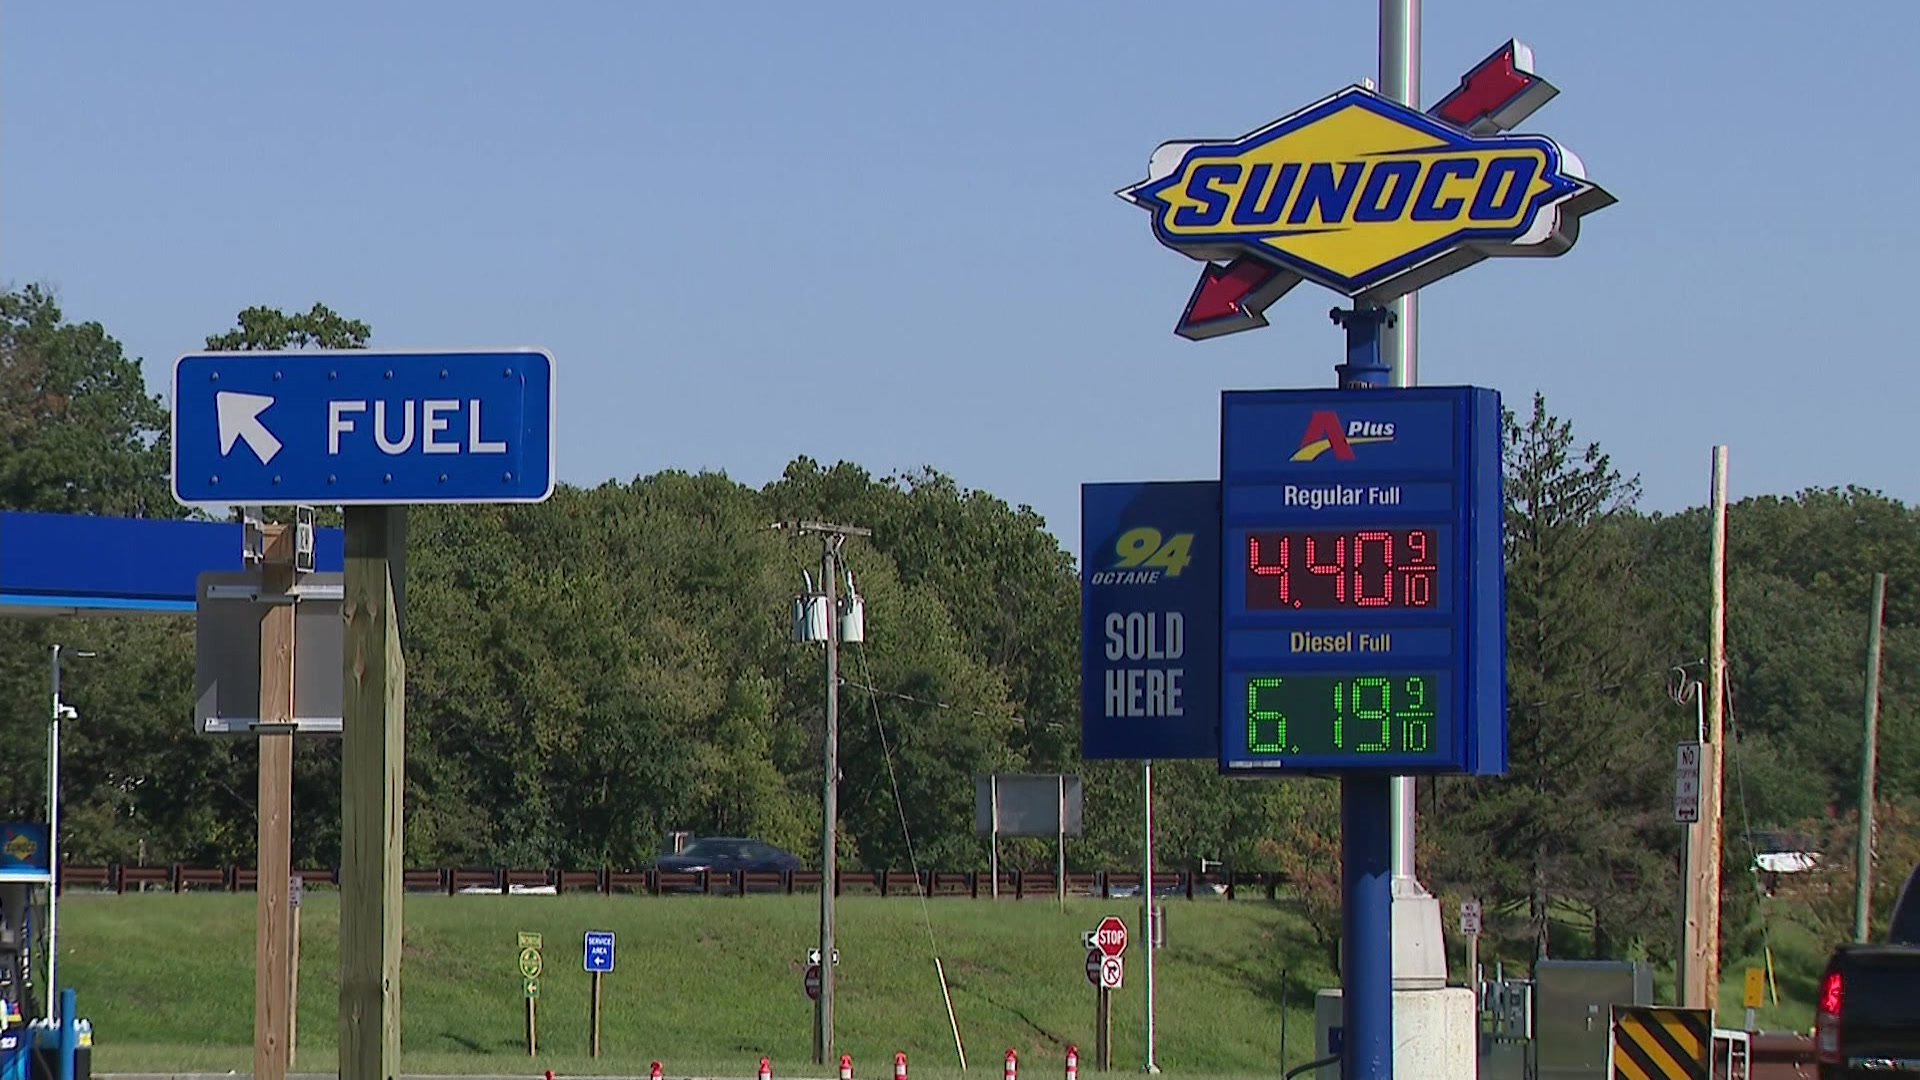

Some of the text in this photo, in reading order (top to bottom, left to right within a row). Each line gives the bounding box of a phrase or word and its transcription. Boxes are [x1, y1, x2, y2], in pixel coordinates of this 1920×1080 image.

[1173, 157, 1539, 227] SUNOCO
[328, 399, 507, 455] FUEL
[1284, 485, 1400, 509] Regular Full
[1114, 527, 1195, 576] 94
[1250, 530, 1393, 608] 4.40
[1091, 571, 1160, 585] OCTANE
[1105, 612, 1184, 661] SOLD
[1290, 631, 1391, 653] Diesel Full
[1105, 669, 1184, 717] HERE
[1248, 677, 1391, 754] 6.19
[1682, 750, 1694, 765] NO
[588, 937, 612, 945] SERVICE
[592, 947, 608, 955] AREA
[1099, 930, 1124, 945] STOP
